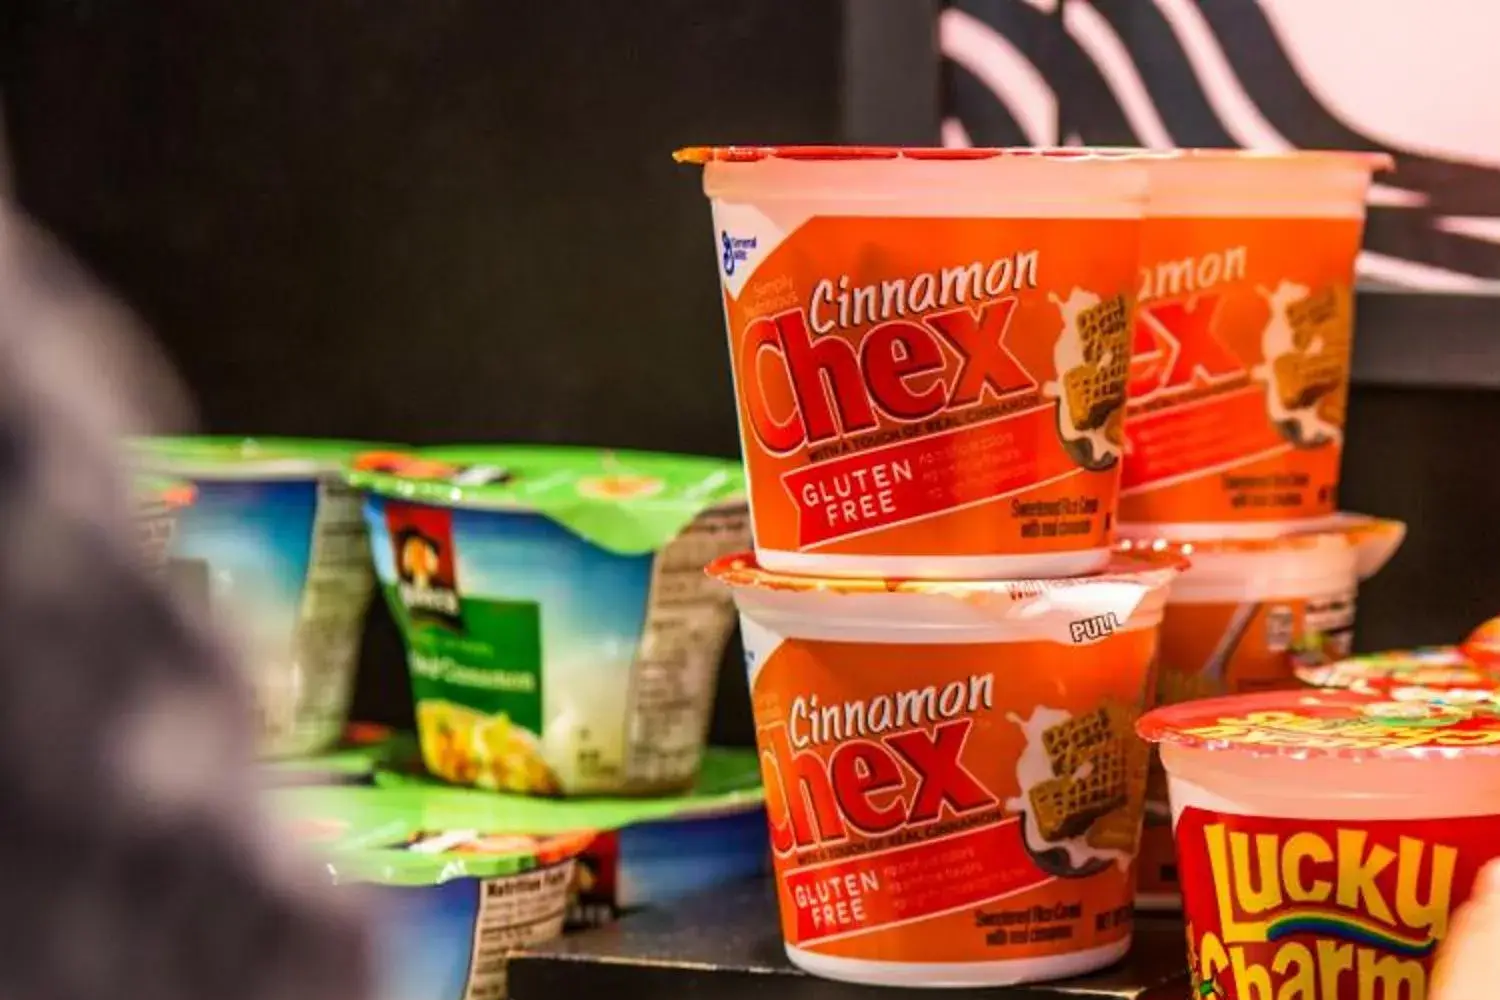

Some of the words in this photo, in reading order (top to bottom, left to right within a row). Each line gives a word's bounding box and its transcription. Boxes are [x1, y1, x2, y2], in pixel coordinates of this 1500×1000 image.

[808, 249, 1039, 334] Cinnamon
[740, 295, 1039, 459] Chex
[801, 458, 914, 509] GLUTEN
[825, 490, 898, 528] FREE
[1069, 611, 1123, 643] PULL
[789, 671, 995, 748] Cinnamon
[794, 869, 880, 909] GLUTEN
[1202, 822, 1459, 944] Lucky
[811, 898, 867, 930] FREE
